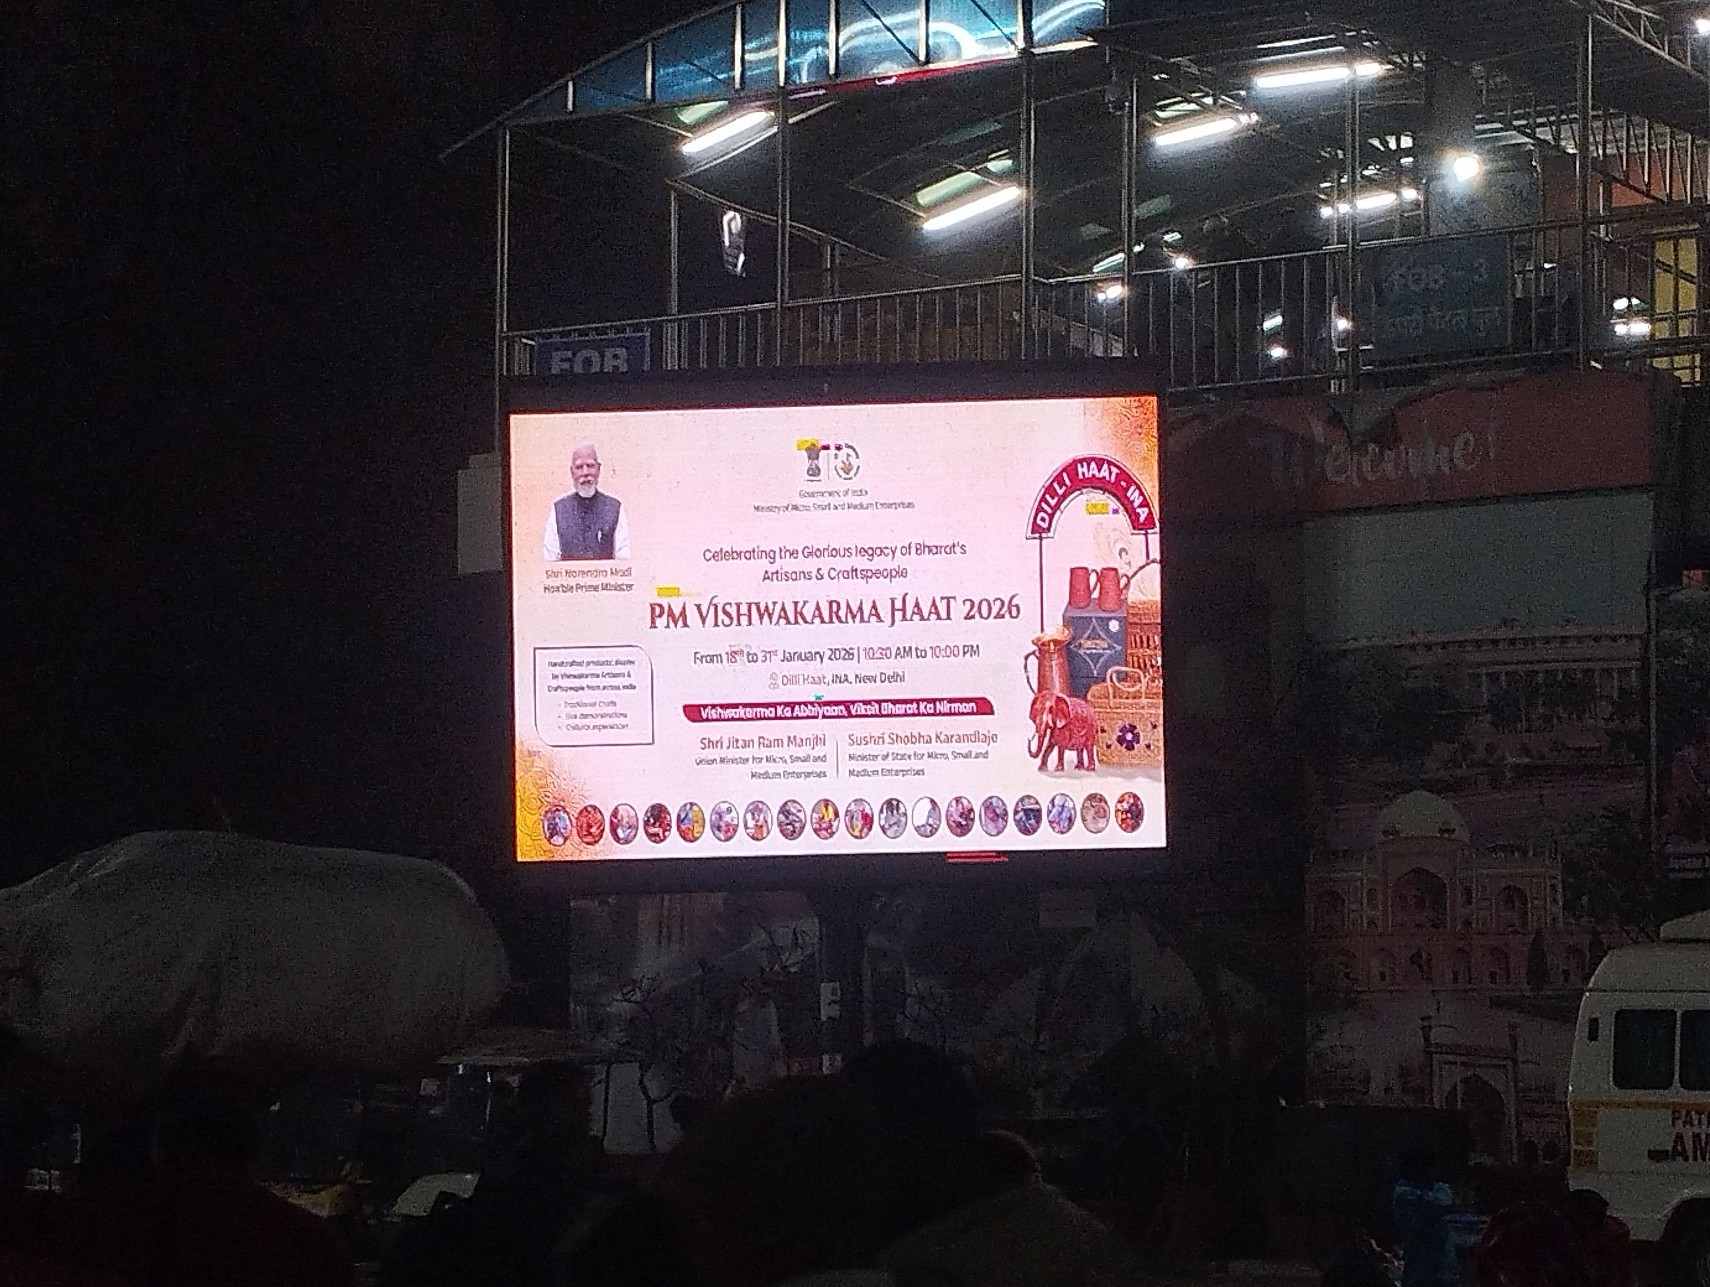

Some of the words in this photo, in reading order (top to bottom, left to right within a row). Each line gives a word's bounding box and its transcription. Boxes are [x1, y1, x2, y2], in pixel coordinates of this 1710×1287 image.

[1036, 472, 1072, 528] DILLI
[1077, 460, 1121, 483] HAAT
[1126, 484, 1149, 524] INA
[703, 545, 776, 564] Celebrating
[779, 545, 799, 560] the
[801, 544, 853, 560] Glorious
[855, 544, 898, 562] legacy
[900, 541, 913, 557] of
[915, 541, 968, 556] Bharat's
[545, 568, 562, 579] Shri
[565, 568, 608, 579] Narendra
[610, 567, 632, 577] Modi
[762, 566, 812, 583] Artisans
[815, 568, 825, 580] &
[827, 565, 909, 584] Craftspeople
[575, 582, 600, 593] Prime
[601, 582, 634, 592] Minister
[649, 601, 690, 629] PM
[693, 594, 885, 628] VISHWAKARMA
[888, 592, 957, 628] HAAT
[962, 593, 1020, 621] 2026
[693, 651, 723, 665] From
[746, 650, 759, 663] to
[780, 649, 825, 665] January
[828, 648, 855, 661] 2026
[894, 645, 912, 659] AM
[915, 646, 928, 659] to
[930, 645, 960, 659] 10:00
[962, 644, 980, 658] PM
[782, 673, 801, 686] Dilli
[855, 673, 878, 684] New
[879, 671, 906, 684] Delhi
[700, 705, 775, 720] Vishwakarma
[776, 705, 791, 717] Ka
[881, 701, 918, 715] Bharat
[919, 701, 934, 715] Ka
[935, 700, 977, 714] Nirman
[700, 736, 723, 750] Shri
[726, 736, 755, 750] Jitan
[758, 736, 784, 749] Ram
[786, 734, 826, 750] Manjhi
[848, 732, 885, 747] Sushri
[888, 731, 932, 746] Shobha
[935, 730, 998, 747] Karandlaje
[719, 756, 750, 765] Minister
[751, 755, 764, 765] for
[789, 754, 811, 763] Small
[812, 753, 827, 763] and
[848, 752, 880, 762] Minister
[913, 751, 925, 761] for
[973, 750, 989, 760] and
